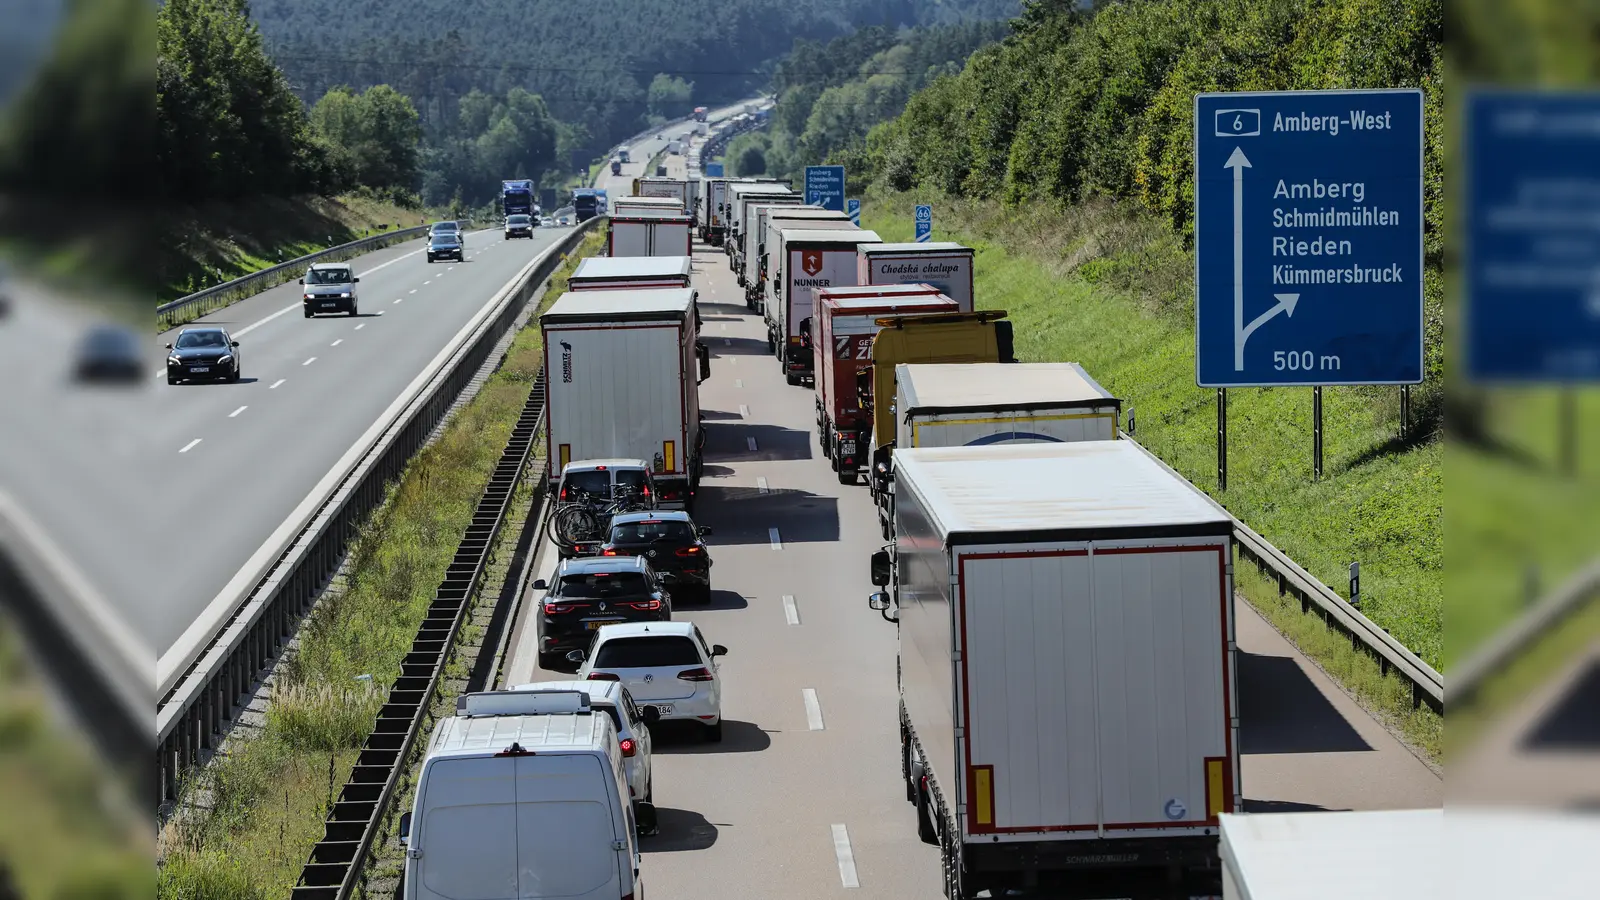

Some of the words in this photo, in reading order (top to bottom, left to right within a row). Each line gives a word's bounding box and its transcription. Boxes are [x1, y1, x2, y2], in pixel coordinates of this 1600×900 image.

[1232, 114, 1243, 131] 6
[1272, 110, 1392, 136] Amberg-West
[1272, 178, 1366, 203] Amberg
[918, 209, 929, 218] 66
[1272, 206, 1400, 228] Schmidmühlen
[1272, 235, 1353, 256] Rieden
[922, 262, 960, 274] chalupa
[1272, 263, 1404, 285] Kümmersbruck
[793, 278, 831, 287] NUNNER
[1272, 350, 1315, 371] 500
[1320, 355, 1341, 370] m
